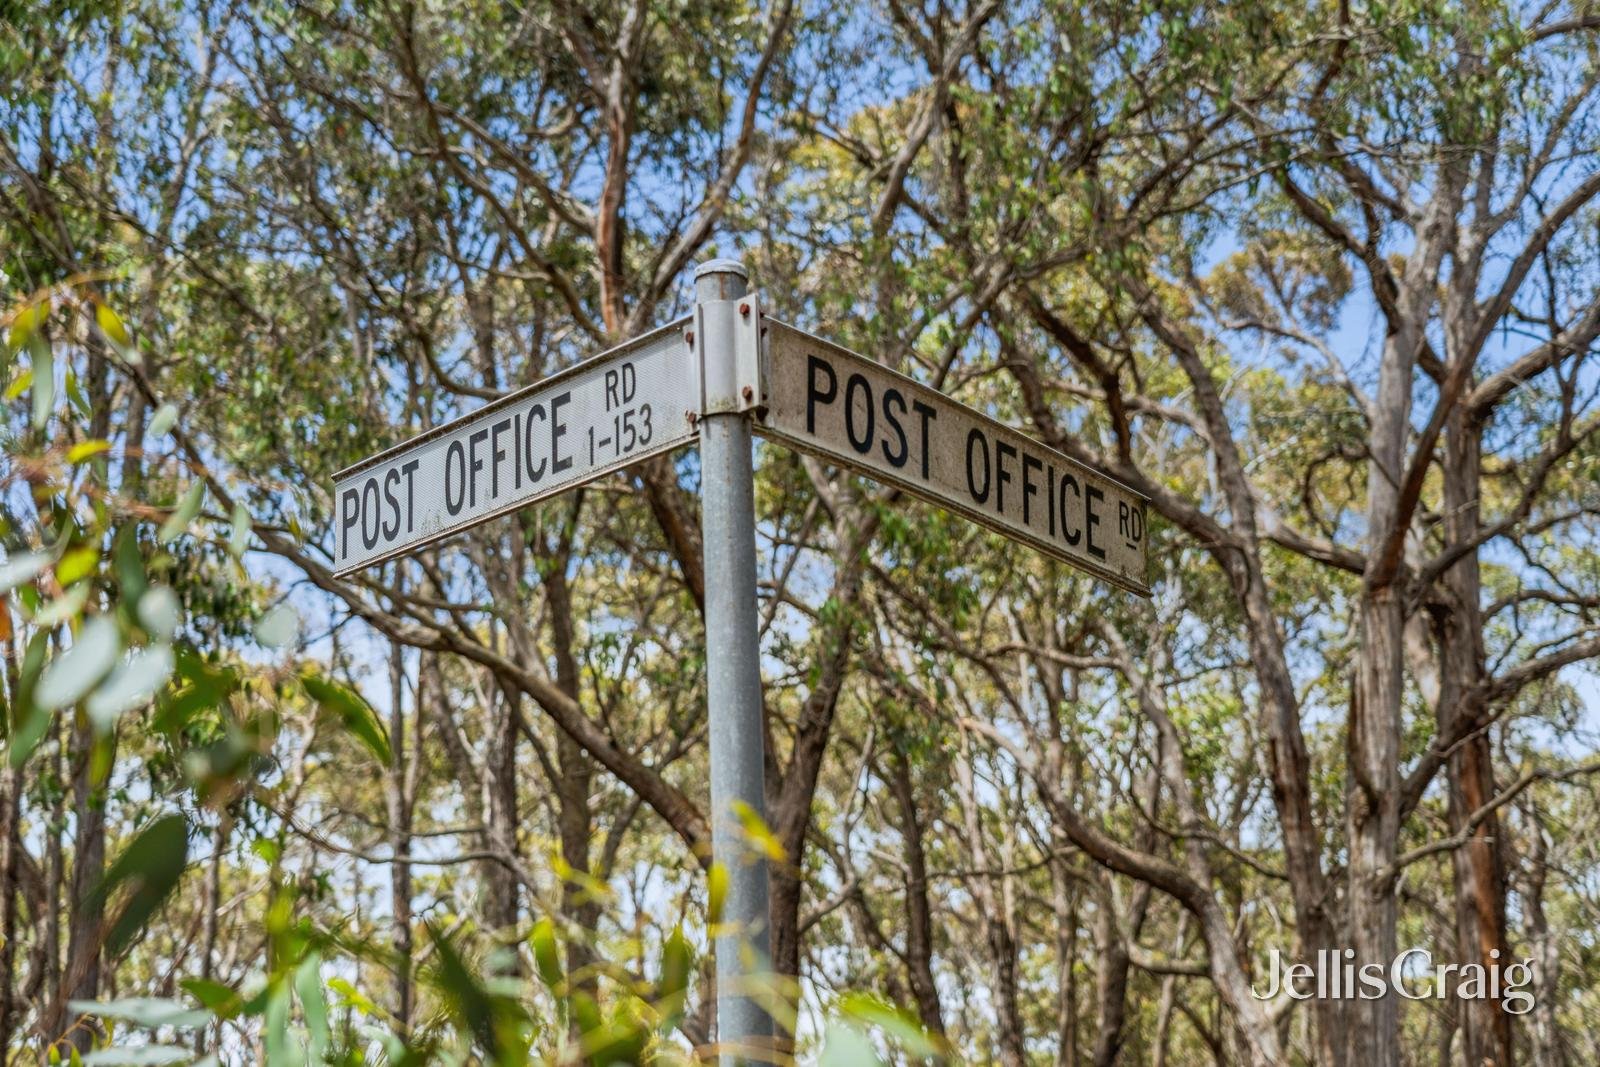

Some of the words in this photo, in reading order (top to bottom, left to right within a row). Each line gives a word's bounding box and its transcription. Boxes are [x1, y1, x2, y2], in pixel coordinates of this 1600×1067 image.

[342, 459, 419, 560] POST
[445, 391, 573, 516] OFFICE
[605, 362, 636, 412] RD
[589, 403, 652, 466] 1-153
[807, 355, 937, 480] POST
[966, 428, 1106, 560] OFFICE
[1119, 501, 1142, 544] RD
